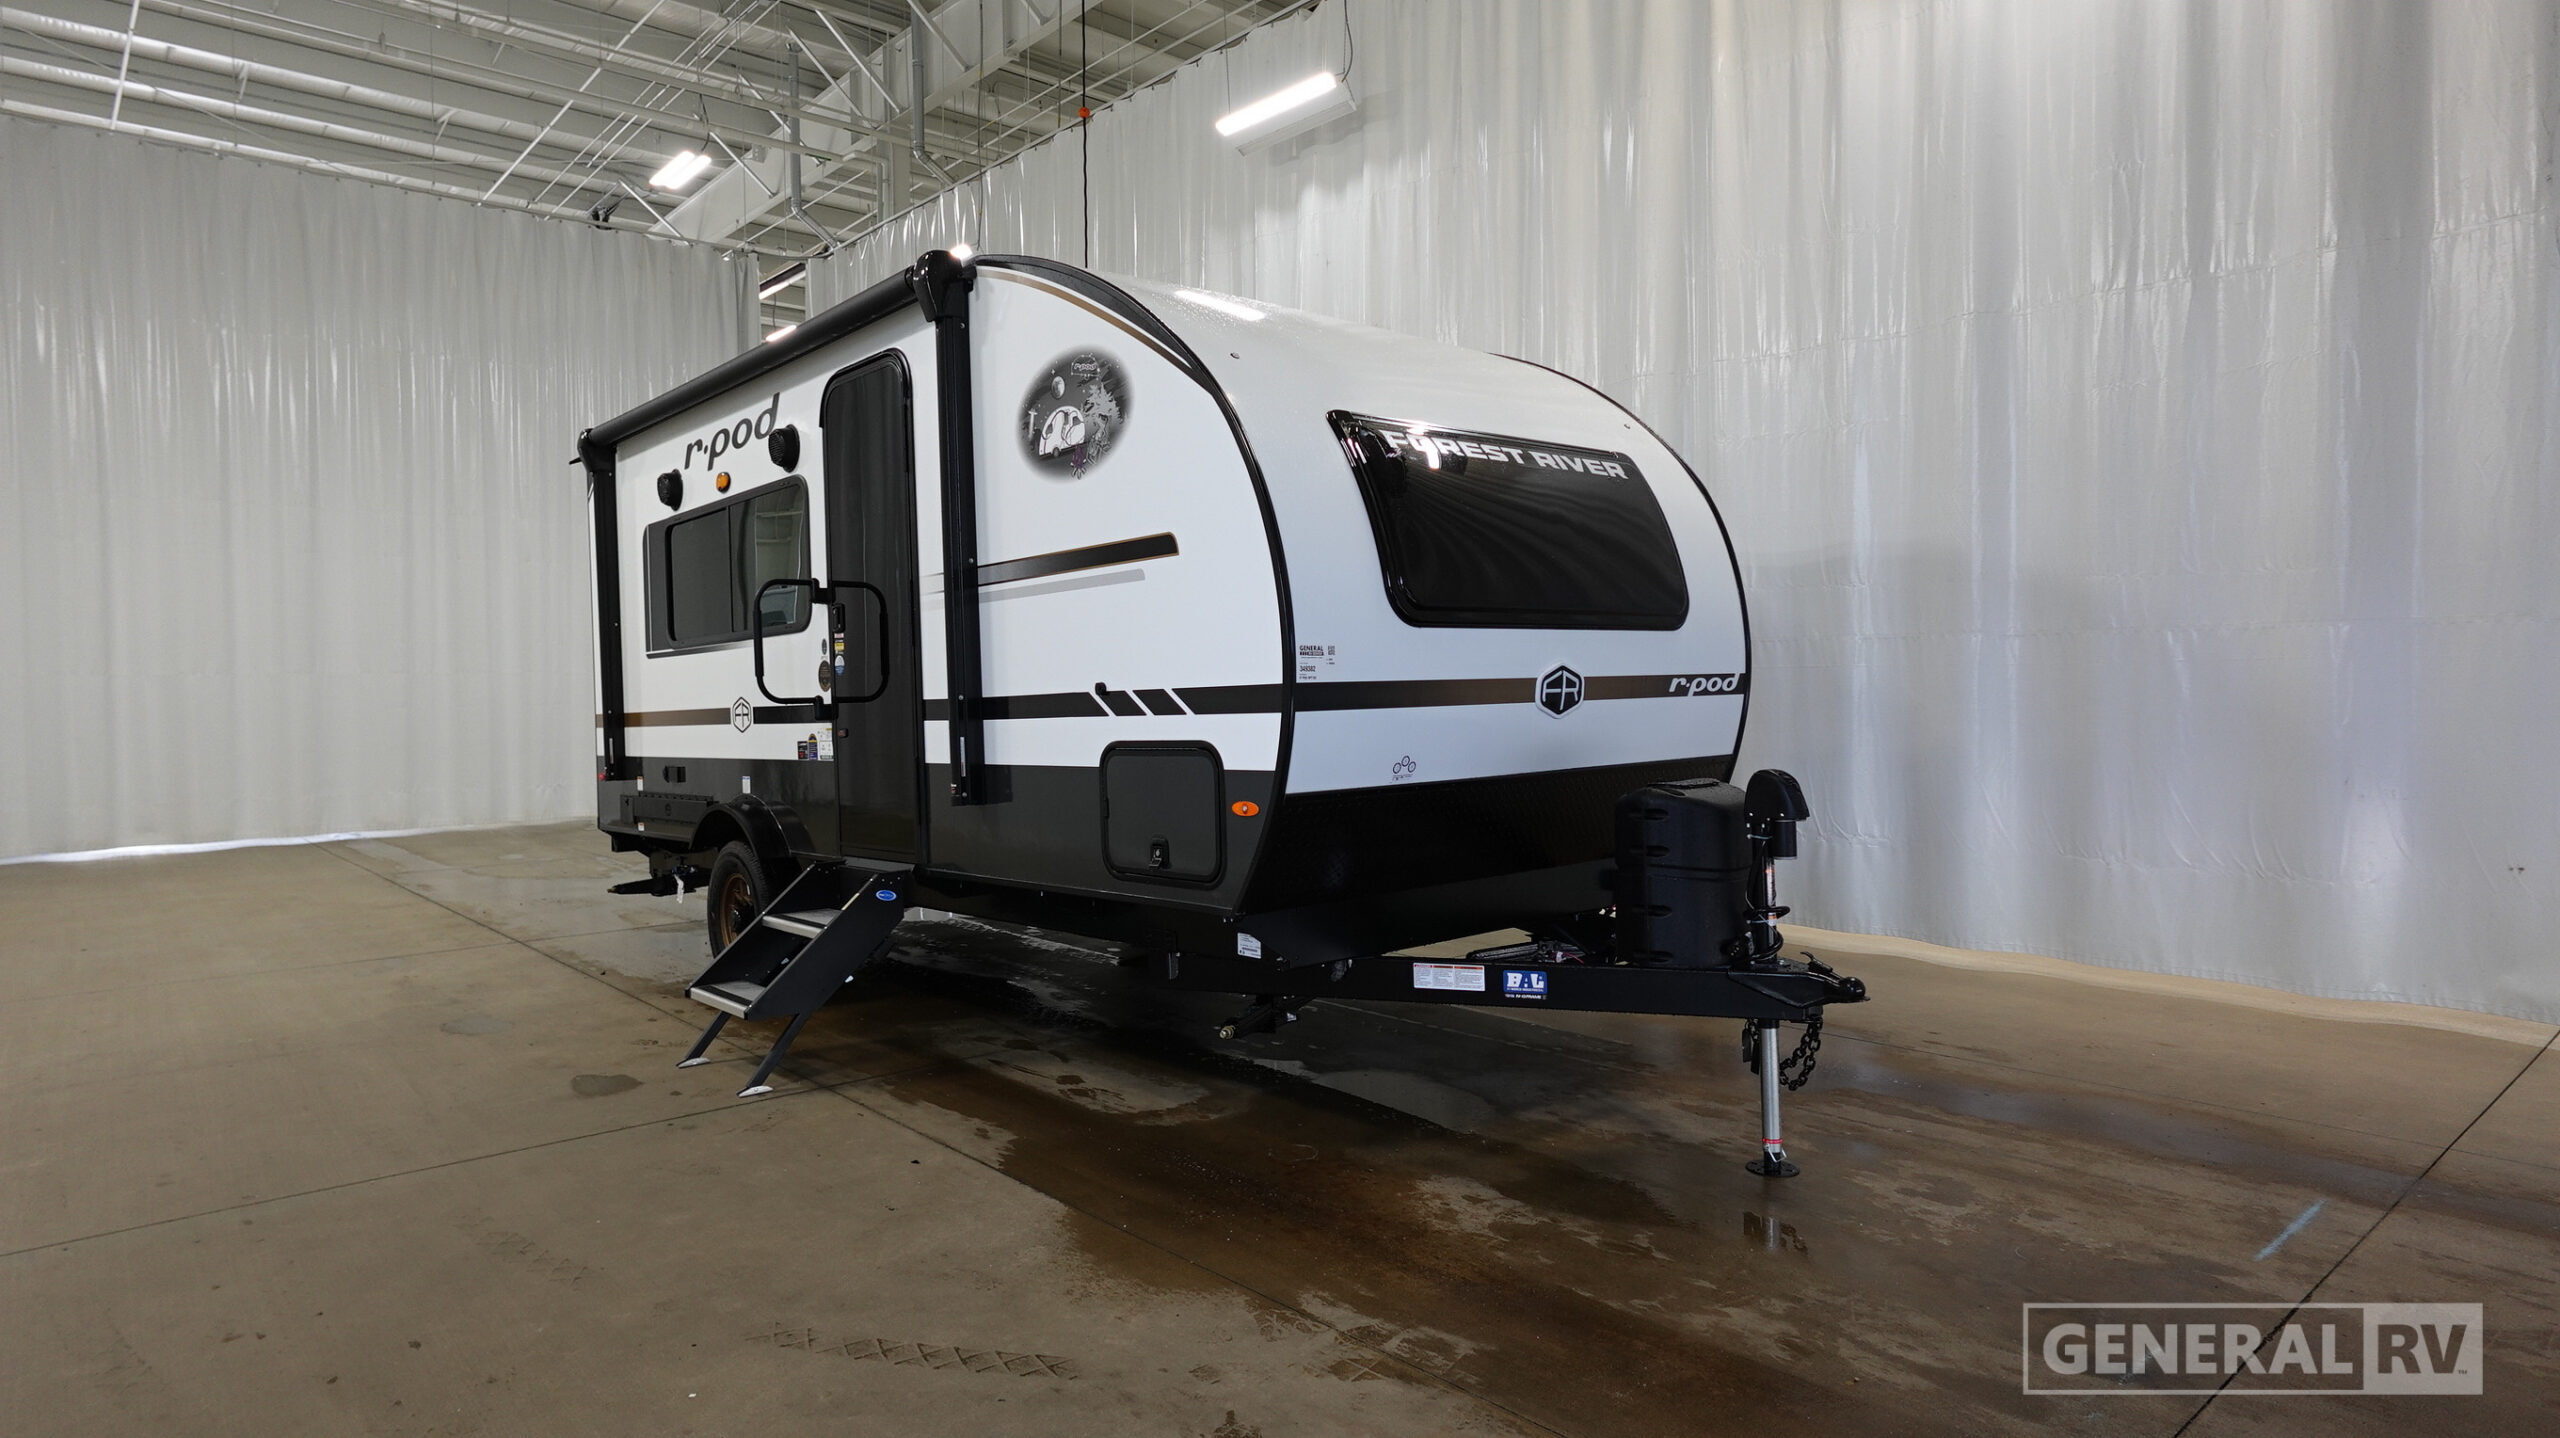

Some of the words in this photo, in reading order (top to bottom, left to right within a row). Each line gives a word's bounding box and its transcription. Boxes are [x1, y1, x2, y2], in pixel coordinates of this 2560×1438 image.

[1380, 429, 1524, 464] FOREST
[1526, 450, 1628, 479] RIVER
[1506, 972, 1544, 989] BAL
